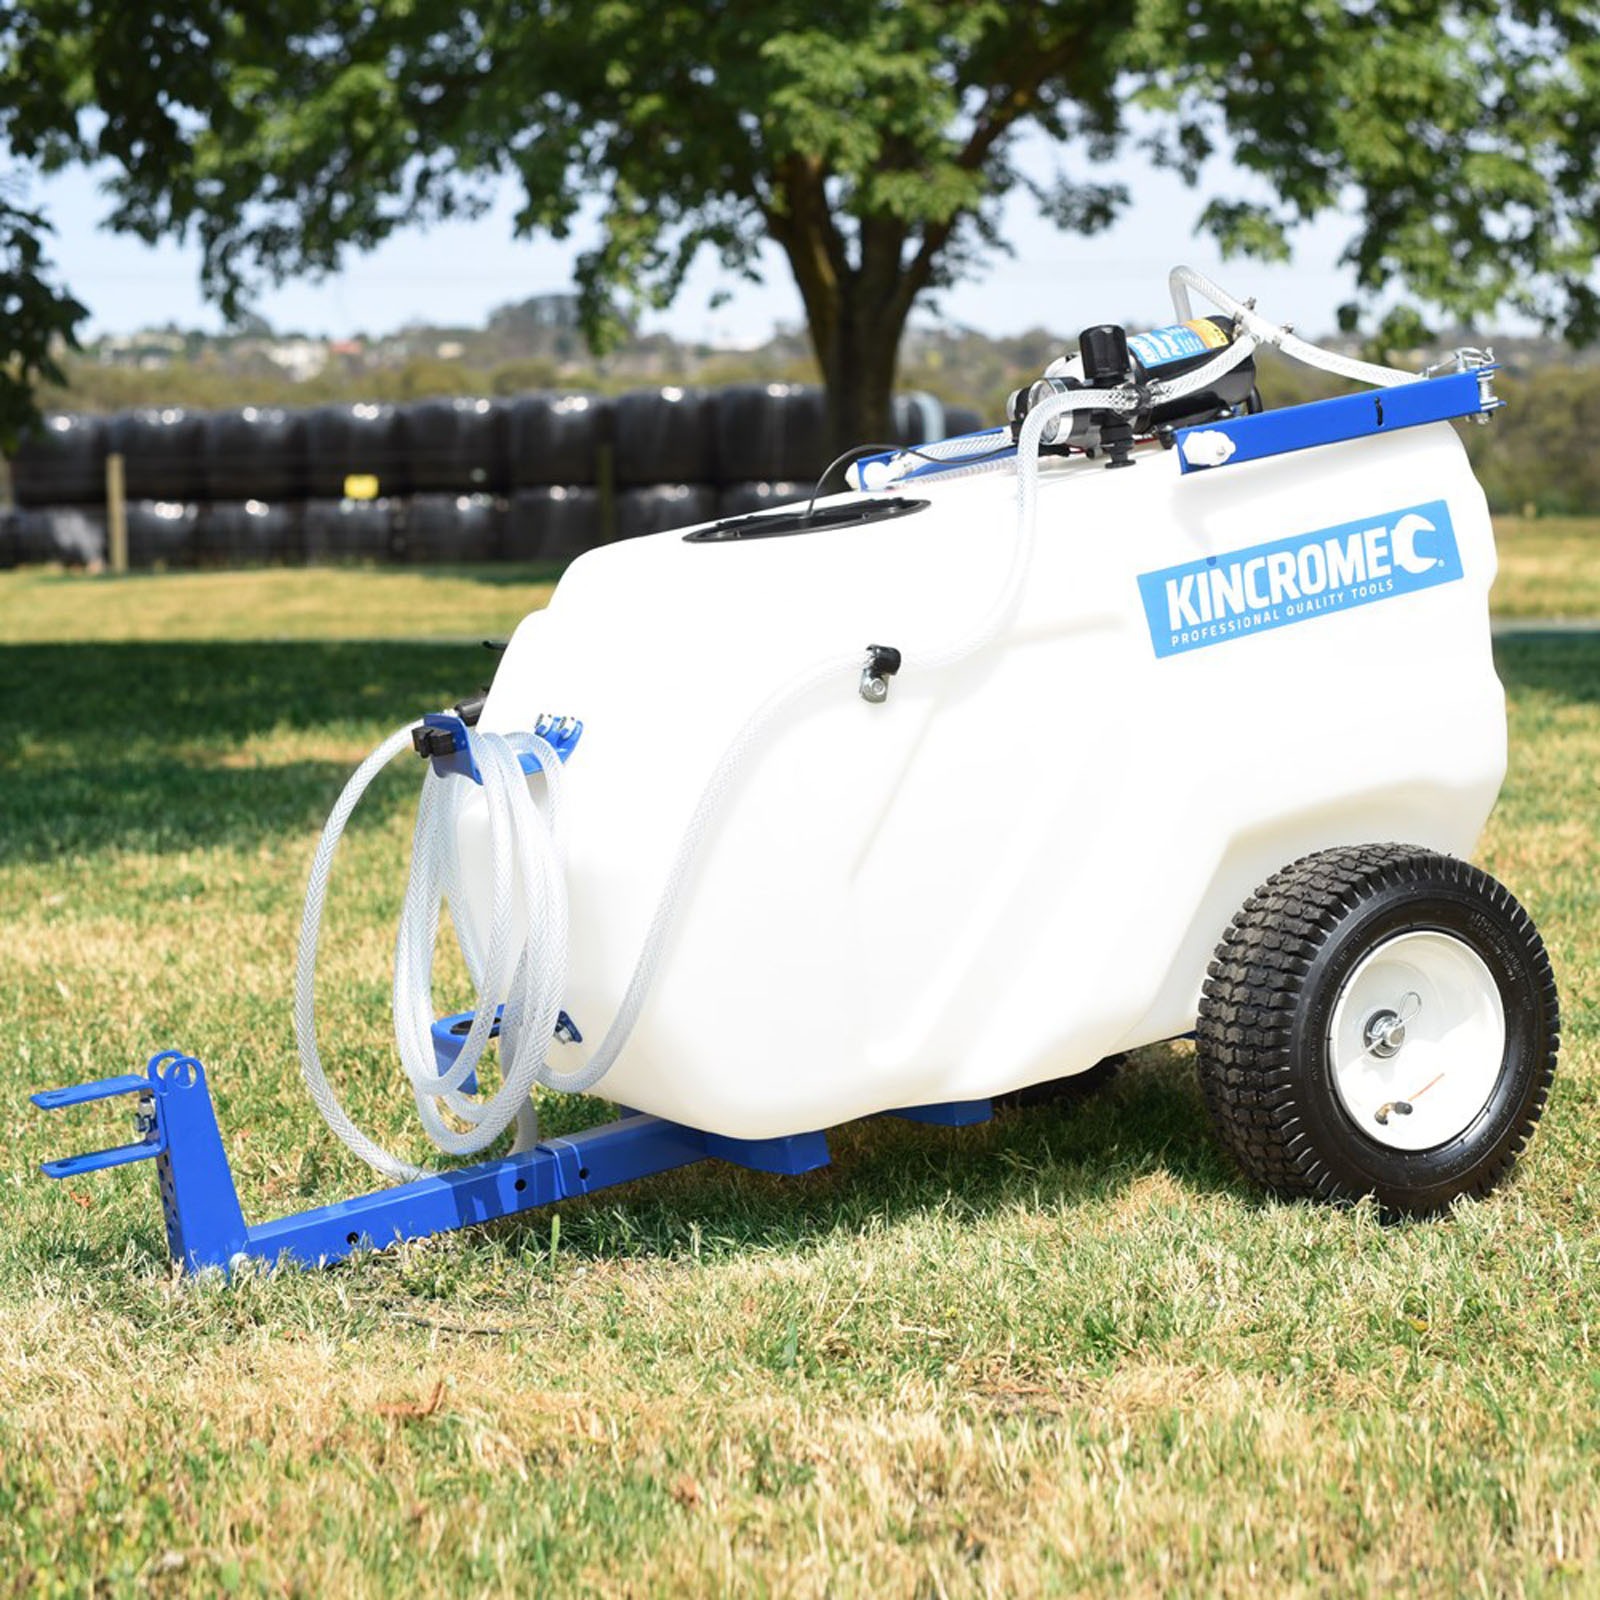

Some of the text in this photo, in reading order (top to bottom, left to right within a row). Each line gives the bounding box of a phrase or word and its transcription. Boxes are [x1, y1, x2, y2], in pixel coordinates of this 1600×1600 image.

[1171, 578, 1394, 647] PROFESSIONAL QUALITY TOOLS
